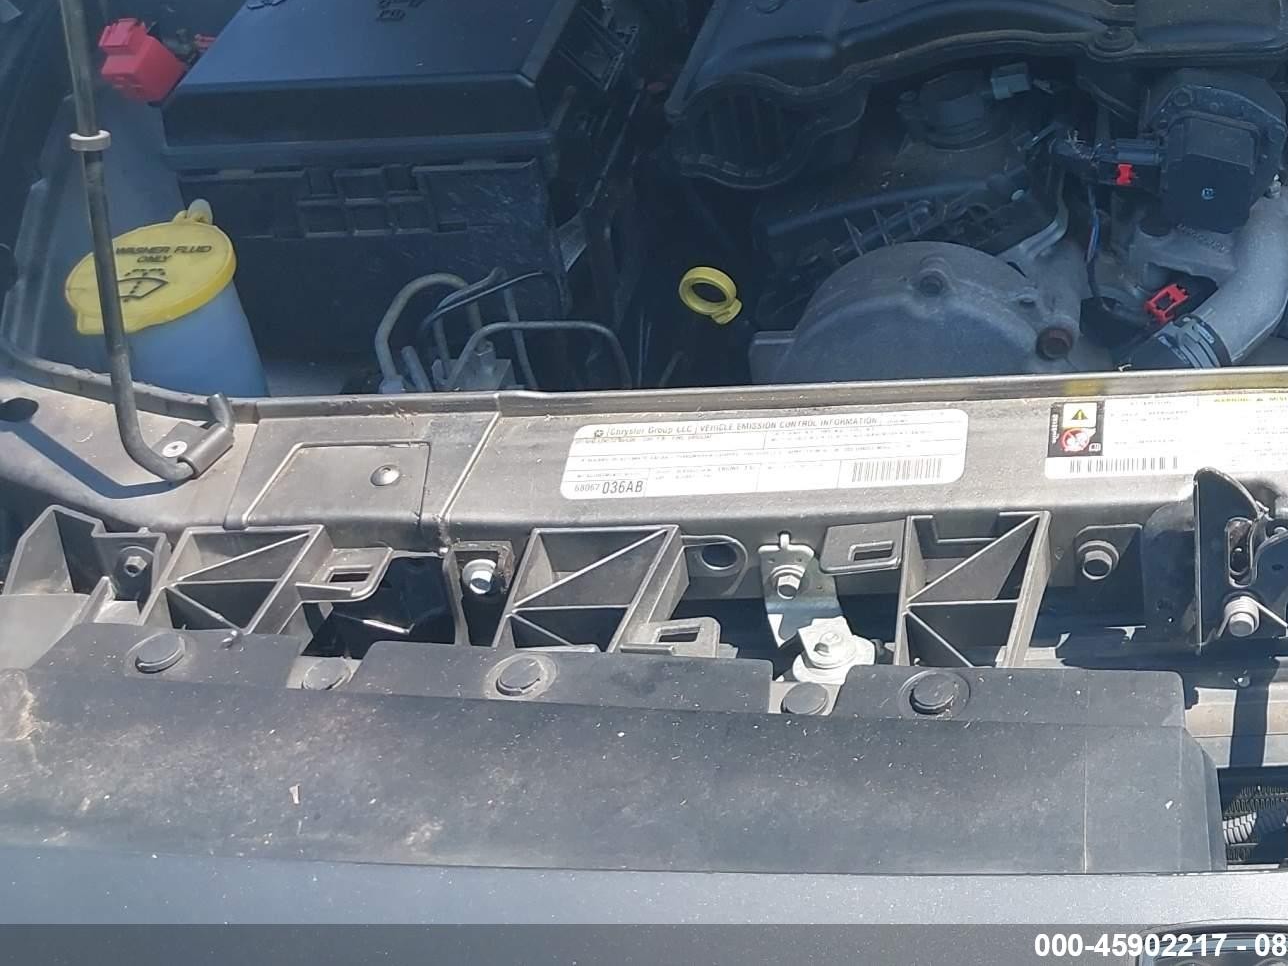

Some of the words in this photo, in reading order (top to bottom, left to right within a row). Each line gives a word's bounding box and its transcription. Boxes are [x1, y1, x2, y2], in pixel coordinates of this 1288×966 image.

[115, 245, 171, 255] WASHER
[174, 244, 213, 254] FLUID
[136, 254, 173, 264] ONLY
[610, 426, 645, 437] Chrysler
[647, 425, 674, 435] Group
[676, 425, 693, 433] LLC
[700, 423, 733, 432] VEHICLE
[736, 421, 777, 431] EMISSION
[779, 420, 817, 429] CONTROL
[820, 417, 878, 427] INFORMATION
[601, 480, 644, 494] 036AB
